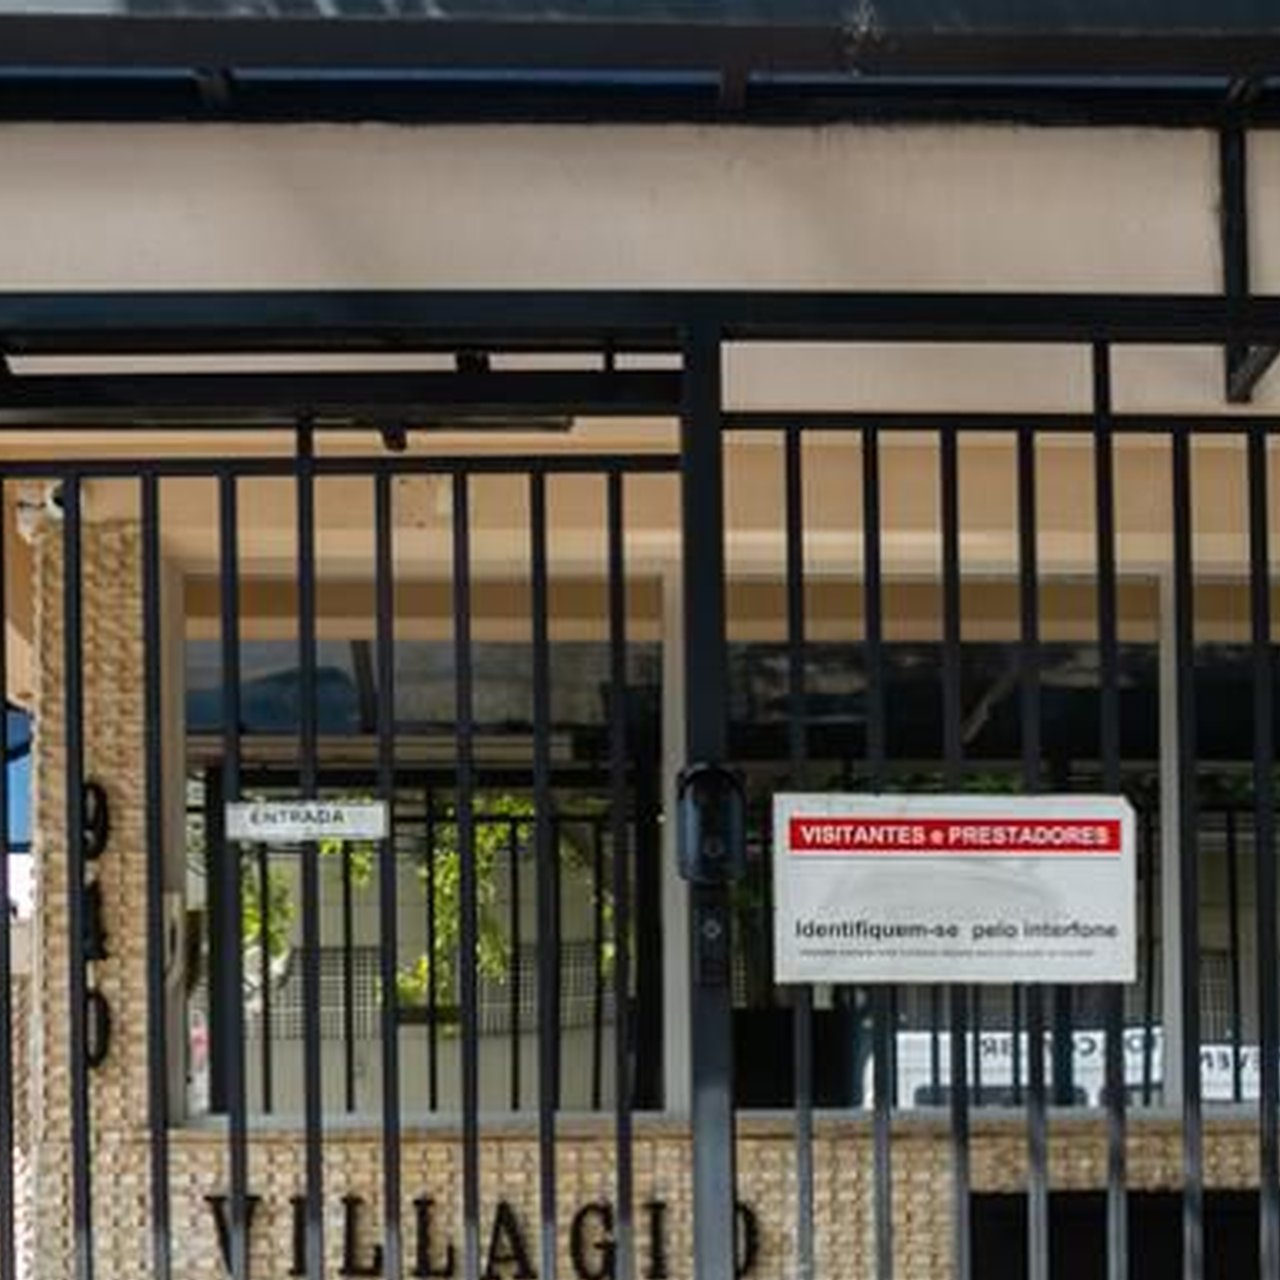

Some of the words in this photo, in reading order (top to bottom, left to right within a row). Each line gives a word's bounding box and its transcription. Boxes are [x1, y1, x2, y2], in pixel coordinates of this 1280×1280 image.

[250, 809, 344, 824] ENTRADA
[800, 826, 925, 844] VISITANTES
[949, 826, 1109, 844] PRESTADORES
[795, 920, 959, 940] Identifiquem-se
[972, 920, 1018, 941] pelo
[1023, 920, 1117, 938] interfone
